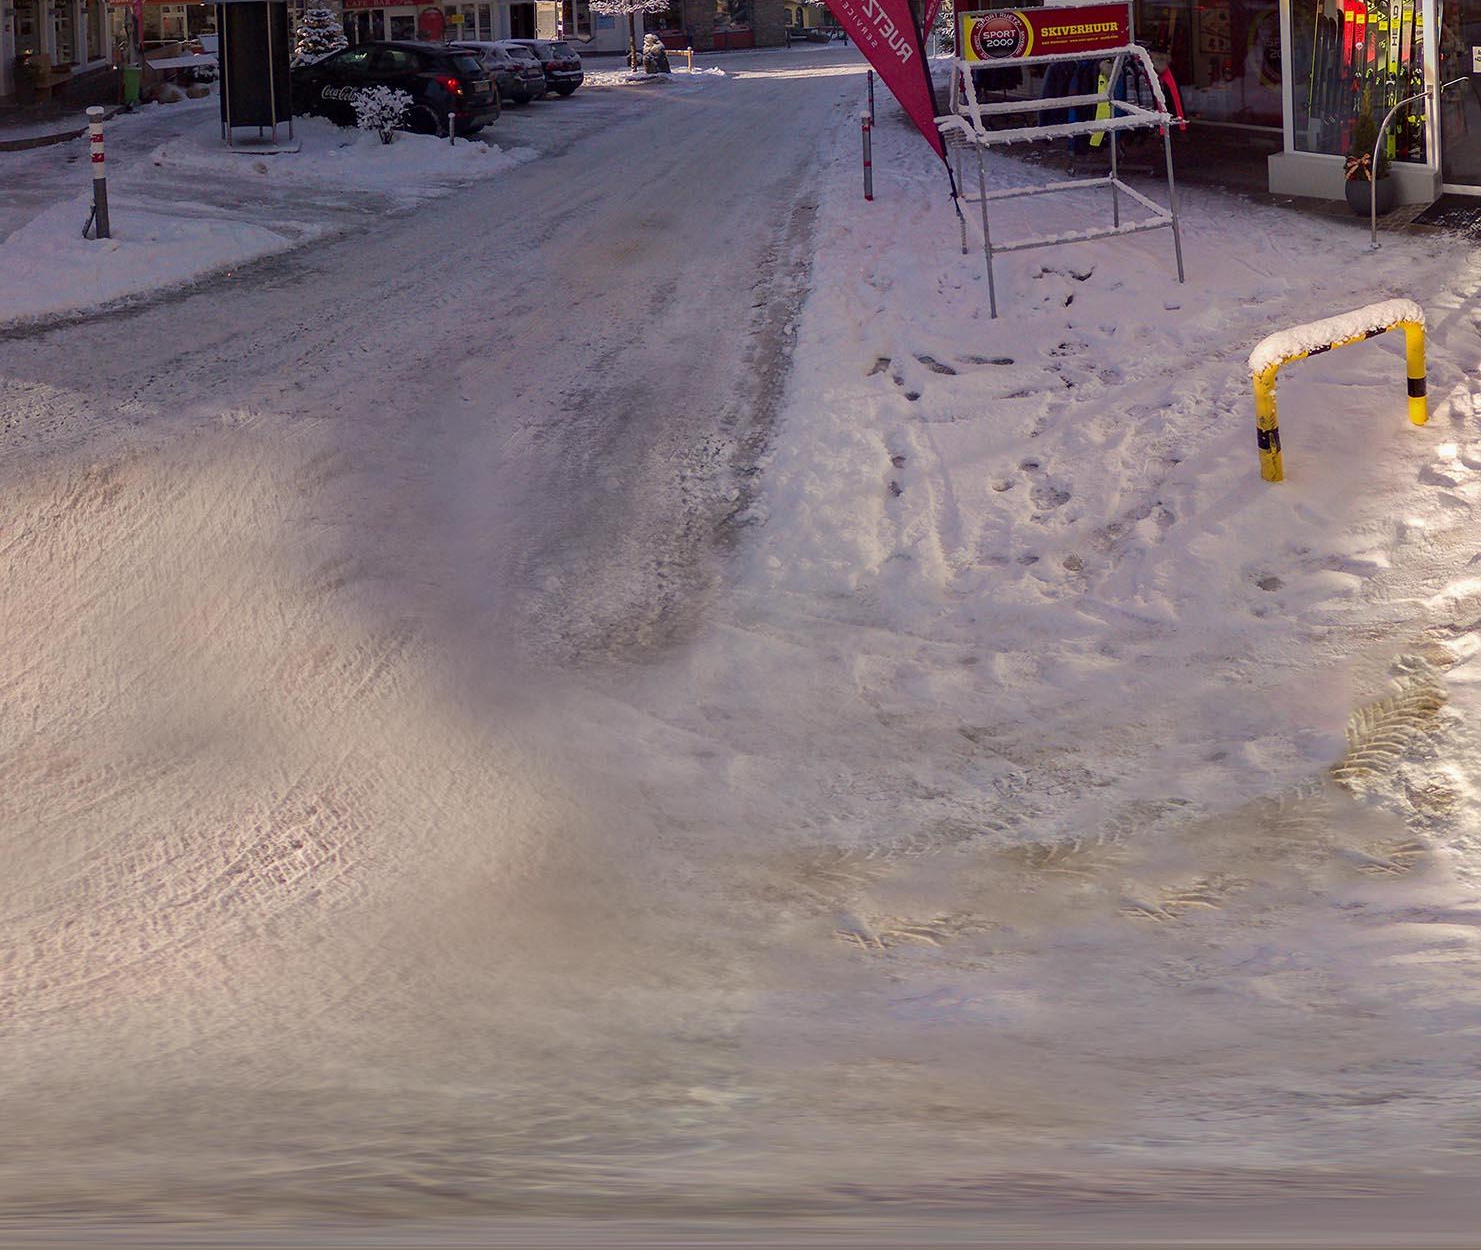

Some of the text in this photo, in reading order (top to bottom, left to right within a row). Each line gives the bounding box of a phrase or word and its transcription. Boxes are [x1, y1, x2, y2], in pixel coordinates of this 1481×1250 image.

[983, 29, 1016, 39] SPORT
[1041, 22, 1119, 37] SKIVERHUUR
[986, 38, 1014, 48] 2000
